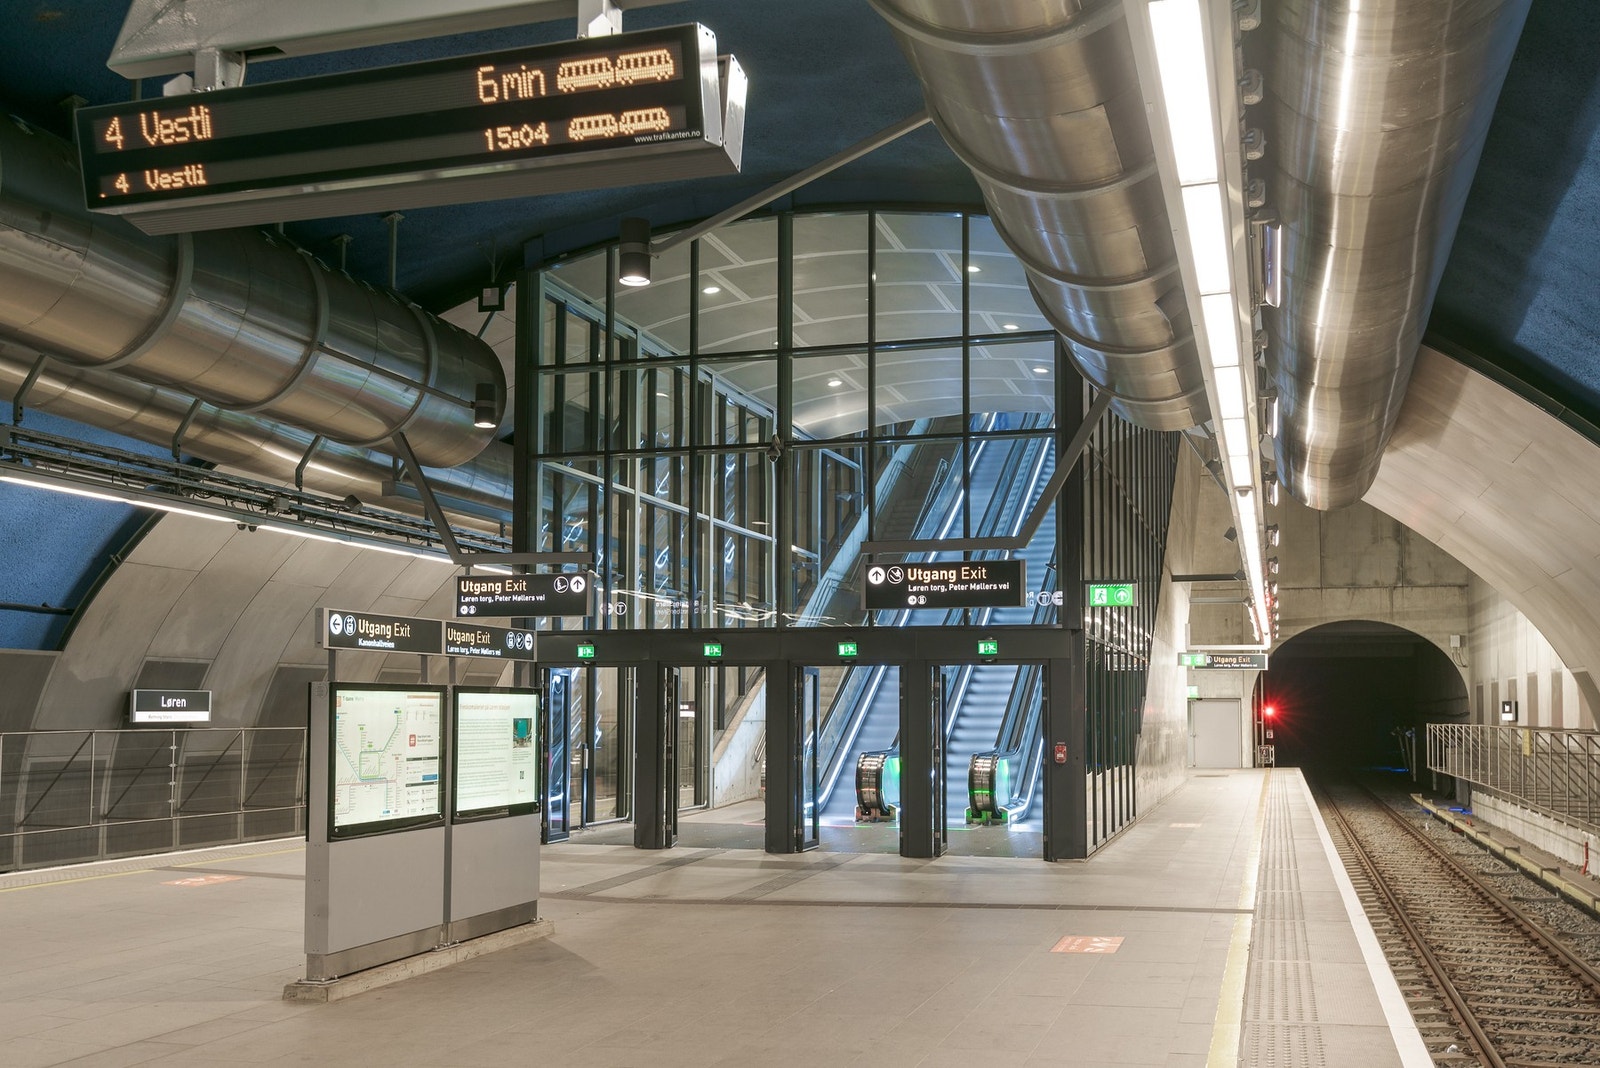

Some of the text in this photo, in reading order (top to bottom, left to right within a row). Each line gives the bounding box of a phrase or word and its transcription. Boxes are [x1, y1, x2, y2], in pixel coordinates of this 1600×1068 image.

[105, 105, 212, 150] 4 Vestli
[485, 122, 549, 151] 15:04
[634, 130, 701, 143] www.trafikanten.no
[115, 164, 206, 193] 4 Vestli
[907, 566, 987, 583] Utgang Exit
[461, 580, 527, 594] Utgang Exit
[908, 582, 1010, 592] Løren torg, Peter Møllers vei
[358, 618, 411, 639] Utgang Exit
[447, 628, 491, 645] Utgang Exit
[1213, 656, 1237, 664] Utgang
[161, 696, 186, 707] Løren
